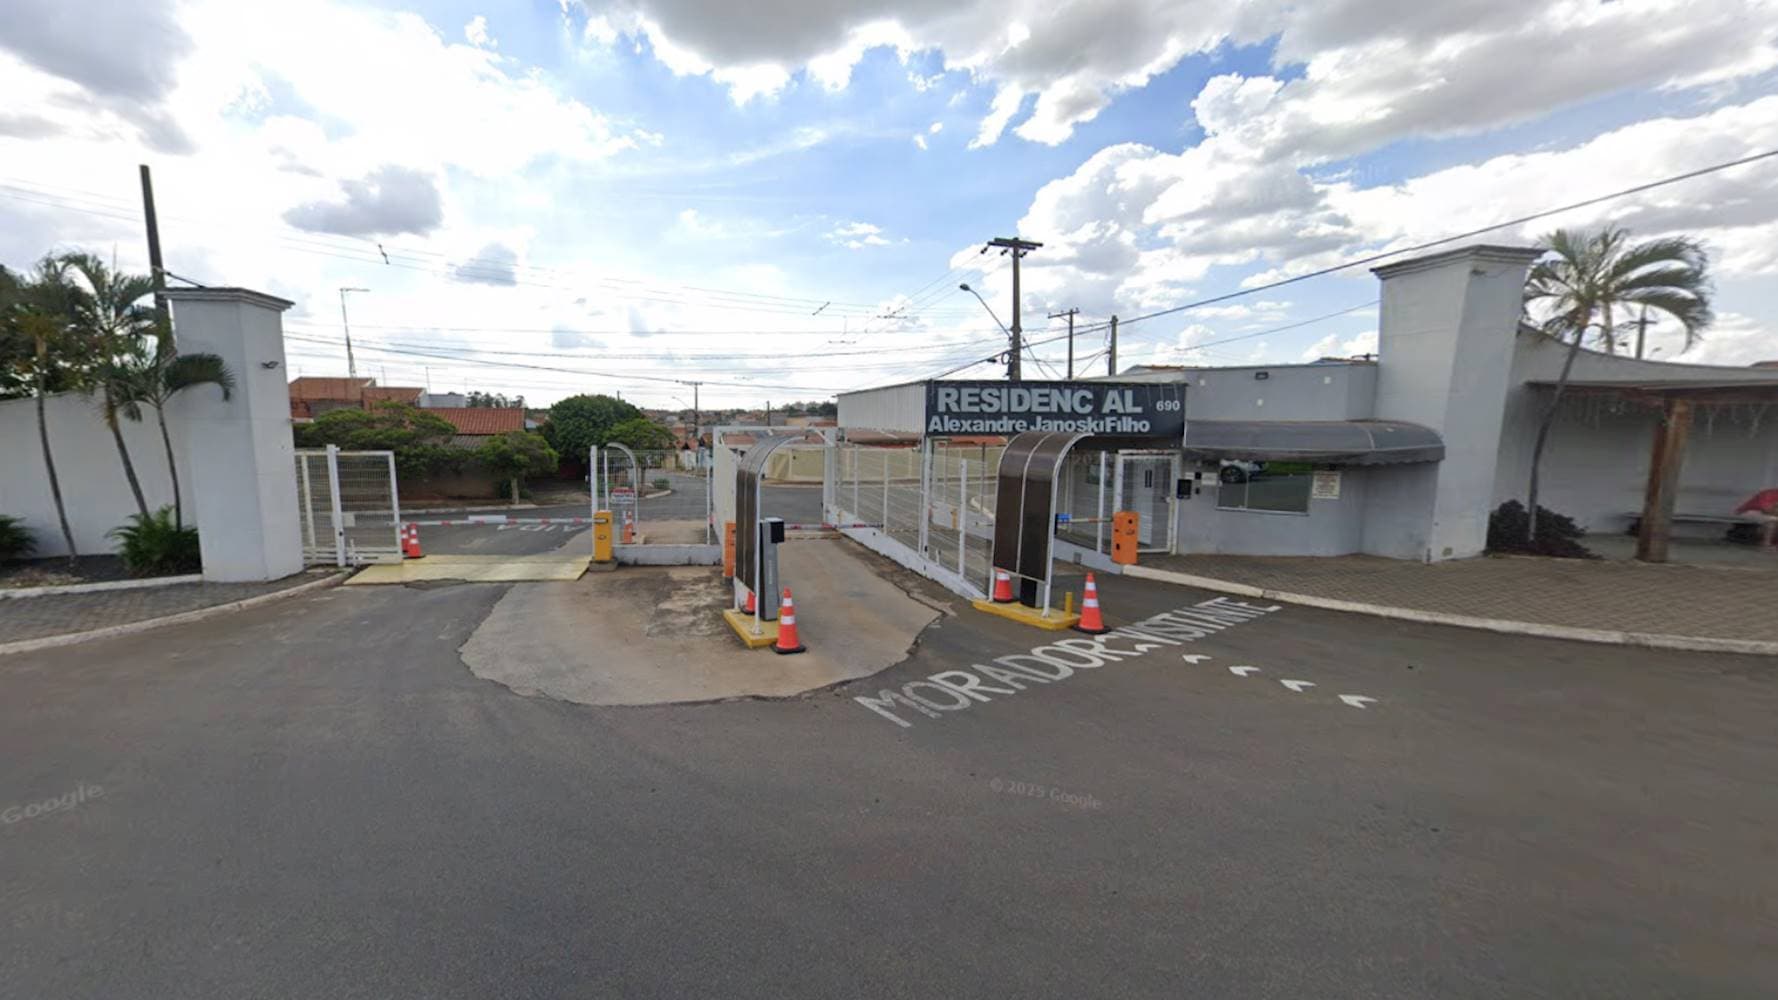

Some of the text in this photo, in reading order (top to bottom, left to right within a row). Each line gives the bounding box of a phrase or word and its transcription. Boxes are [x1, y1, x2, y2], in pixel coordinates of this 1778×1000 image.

[1156, 400, 1181, 411] 690
[928, 415, 1027, 432] Alexandre
[853, 596, 1283, 728] MORADOR VISITANTE
